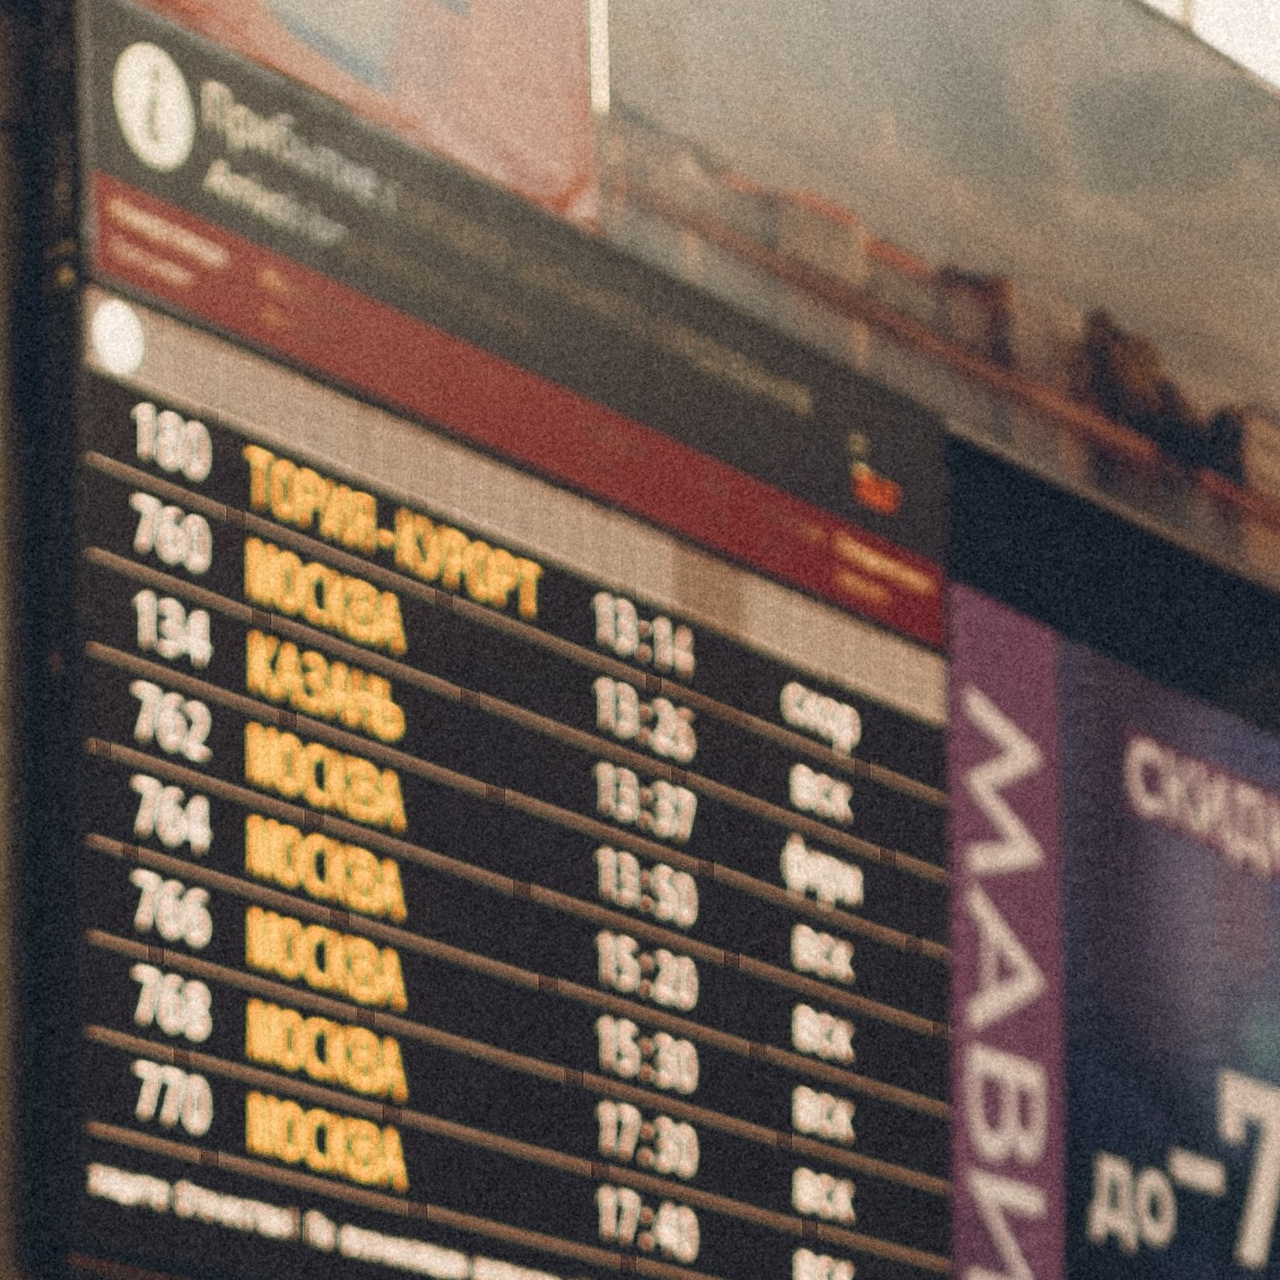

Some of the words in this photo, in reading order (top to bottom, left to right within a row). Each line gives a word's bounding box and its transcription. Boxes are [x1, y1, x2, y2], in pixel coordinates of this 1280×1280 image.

[131, 402, 212, 481] 180
[130, 491, 212, 574] 760
[244, 538, 406, 652] МОСКВА
[132, 589, 212, 667] 134
[247, 630, 406, 741] КАЗАНЬ
[130, 679, 212, 762] 762
[244, 722, 406, 831] МОСКВА
[130, 773, 212, 855] 764
[245, 814, 407, 922] МОСКВА
[595, 929, 700, 1010] 15:20
[130, 868, 212, 948] 766
[245, 907, 407, 1011] МОСКВА
[595, 1014, 700, 1094] 15:30
[130, 963, 212, 1042] 768
[245, 999, 408, 1101] МОСКВА
[596, 1099, 700, 1178] 17:30
[132, 1060, 212, 1135] 770
[245, 1092, 408, 1193] МОСКВА
